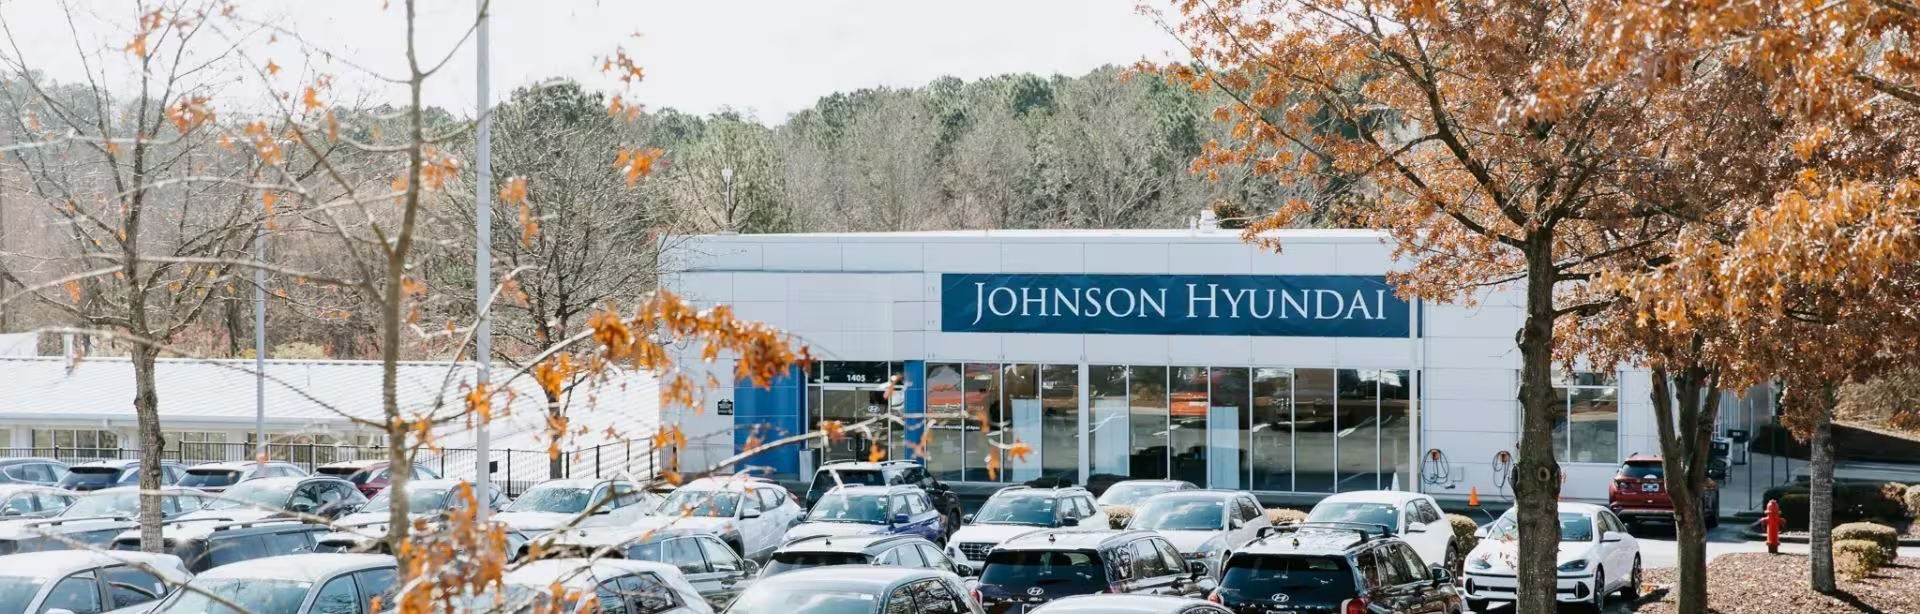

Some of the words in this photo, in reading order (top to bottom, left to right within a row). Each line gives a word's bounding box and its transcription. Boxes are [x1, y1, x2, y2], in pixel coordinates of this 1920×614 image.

[972, 282, 1168, 326] JOHNSON
[1186, 283, 1388, 320] HYUNDAI
[846, 374, 866, 382] 1405
